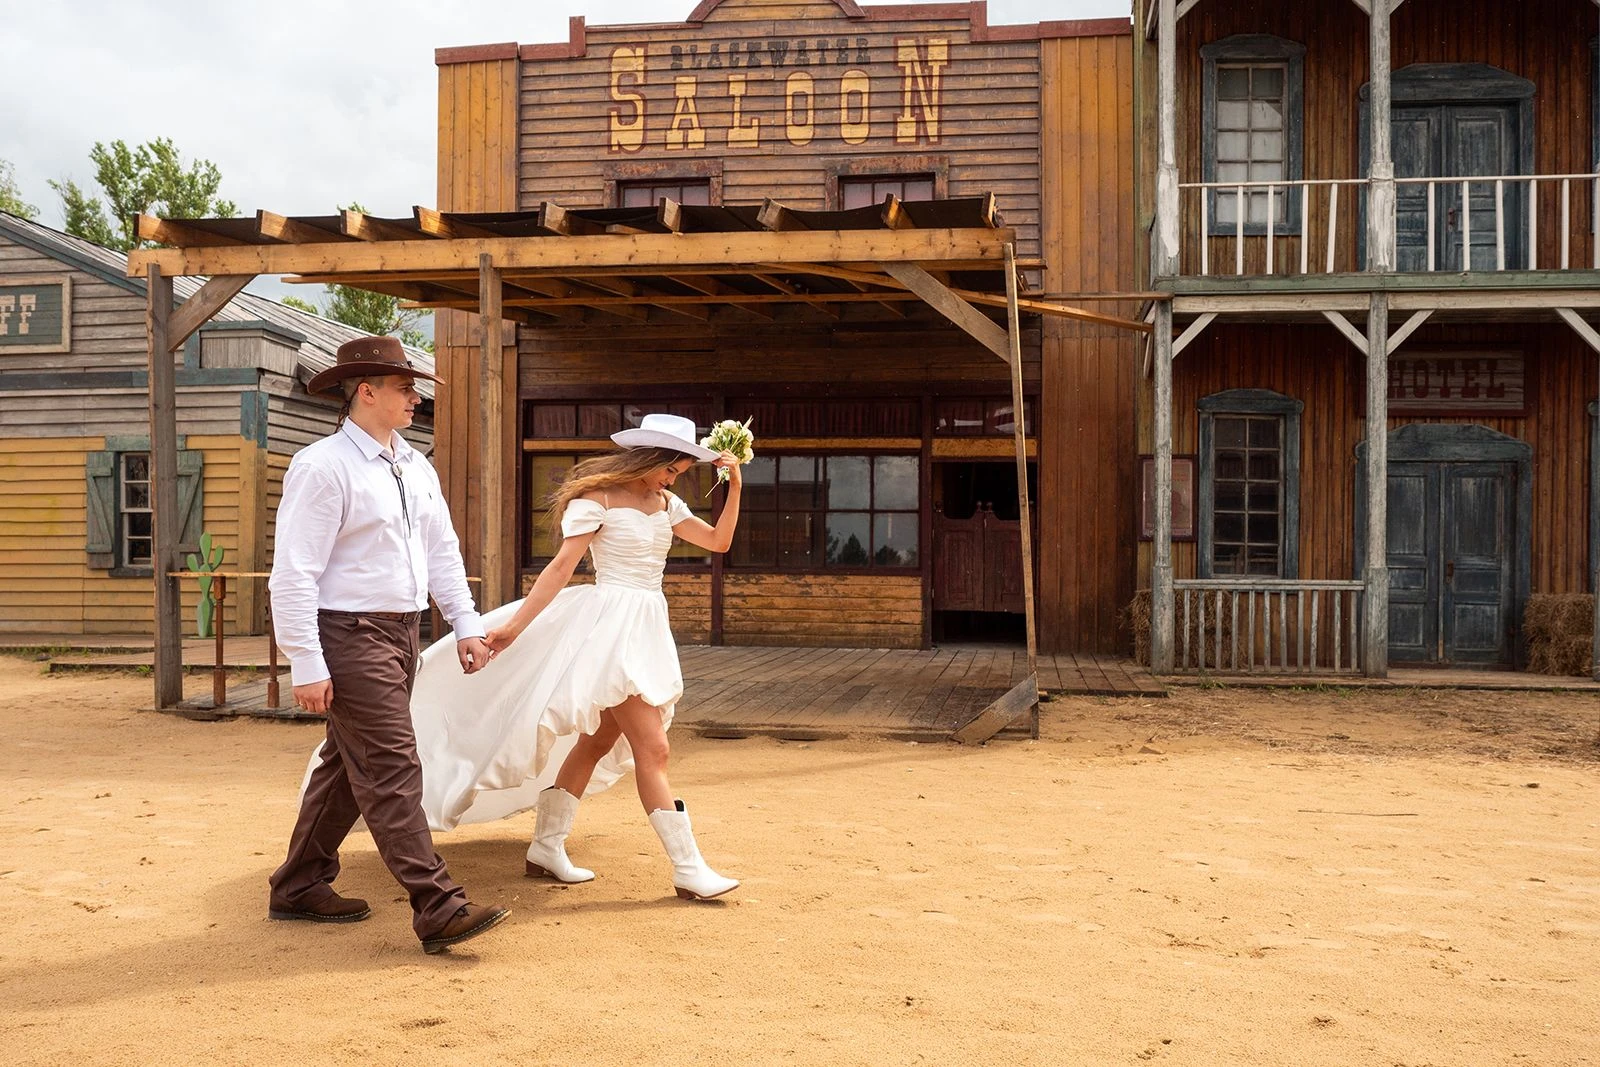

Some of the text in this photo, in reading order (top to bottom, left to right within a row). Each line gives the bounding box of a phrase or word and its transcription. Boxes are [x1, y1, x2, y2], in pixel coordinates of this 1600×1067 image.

[670, 38, 871, 70] BLACKWATER
[607, 37, 952, 154] SALOON
[1387, 359, 1505, 398] HOTEL
